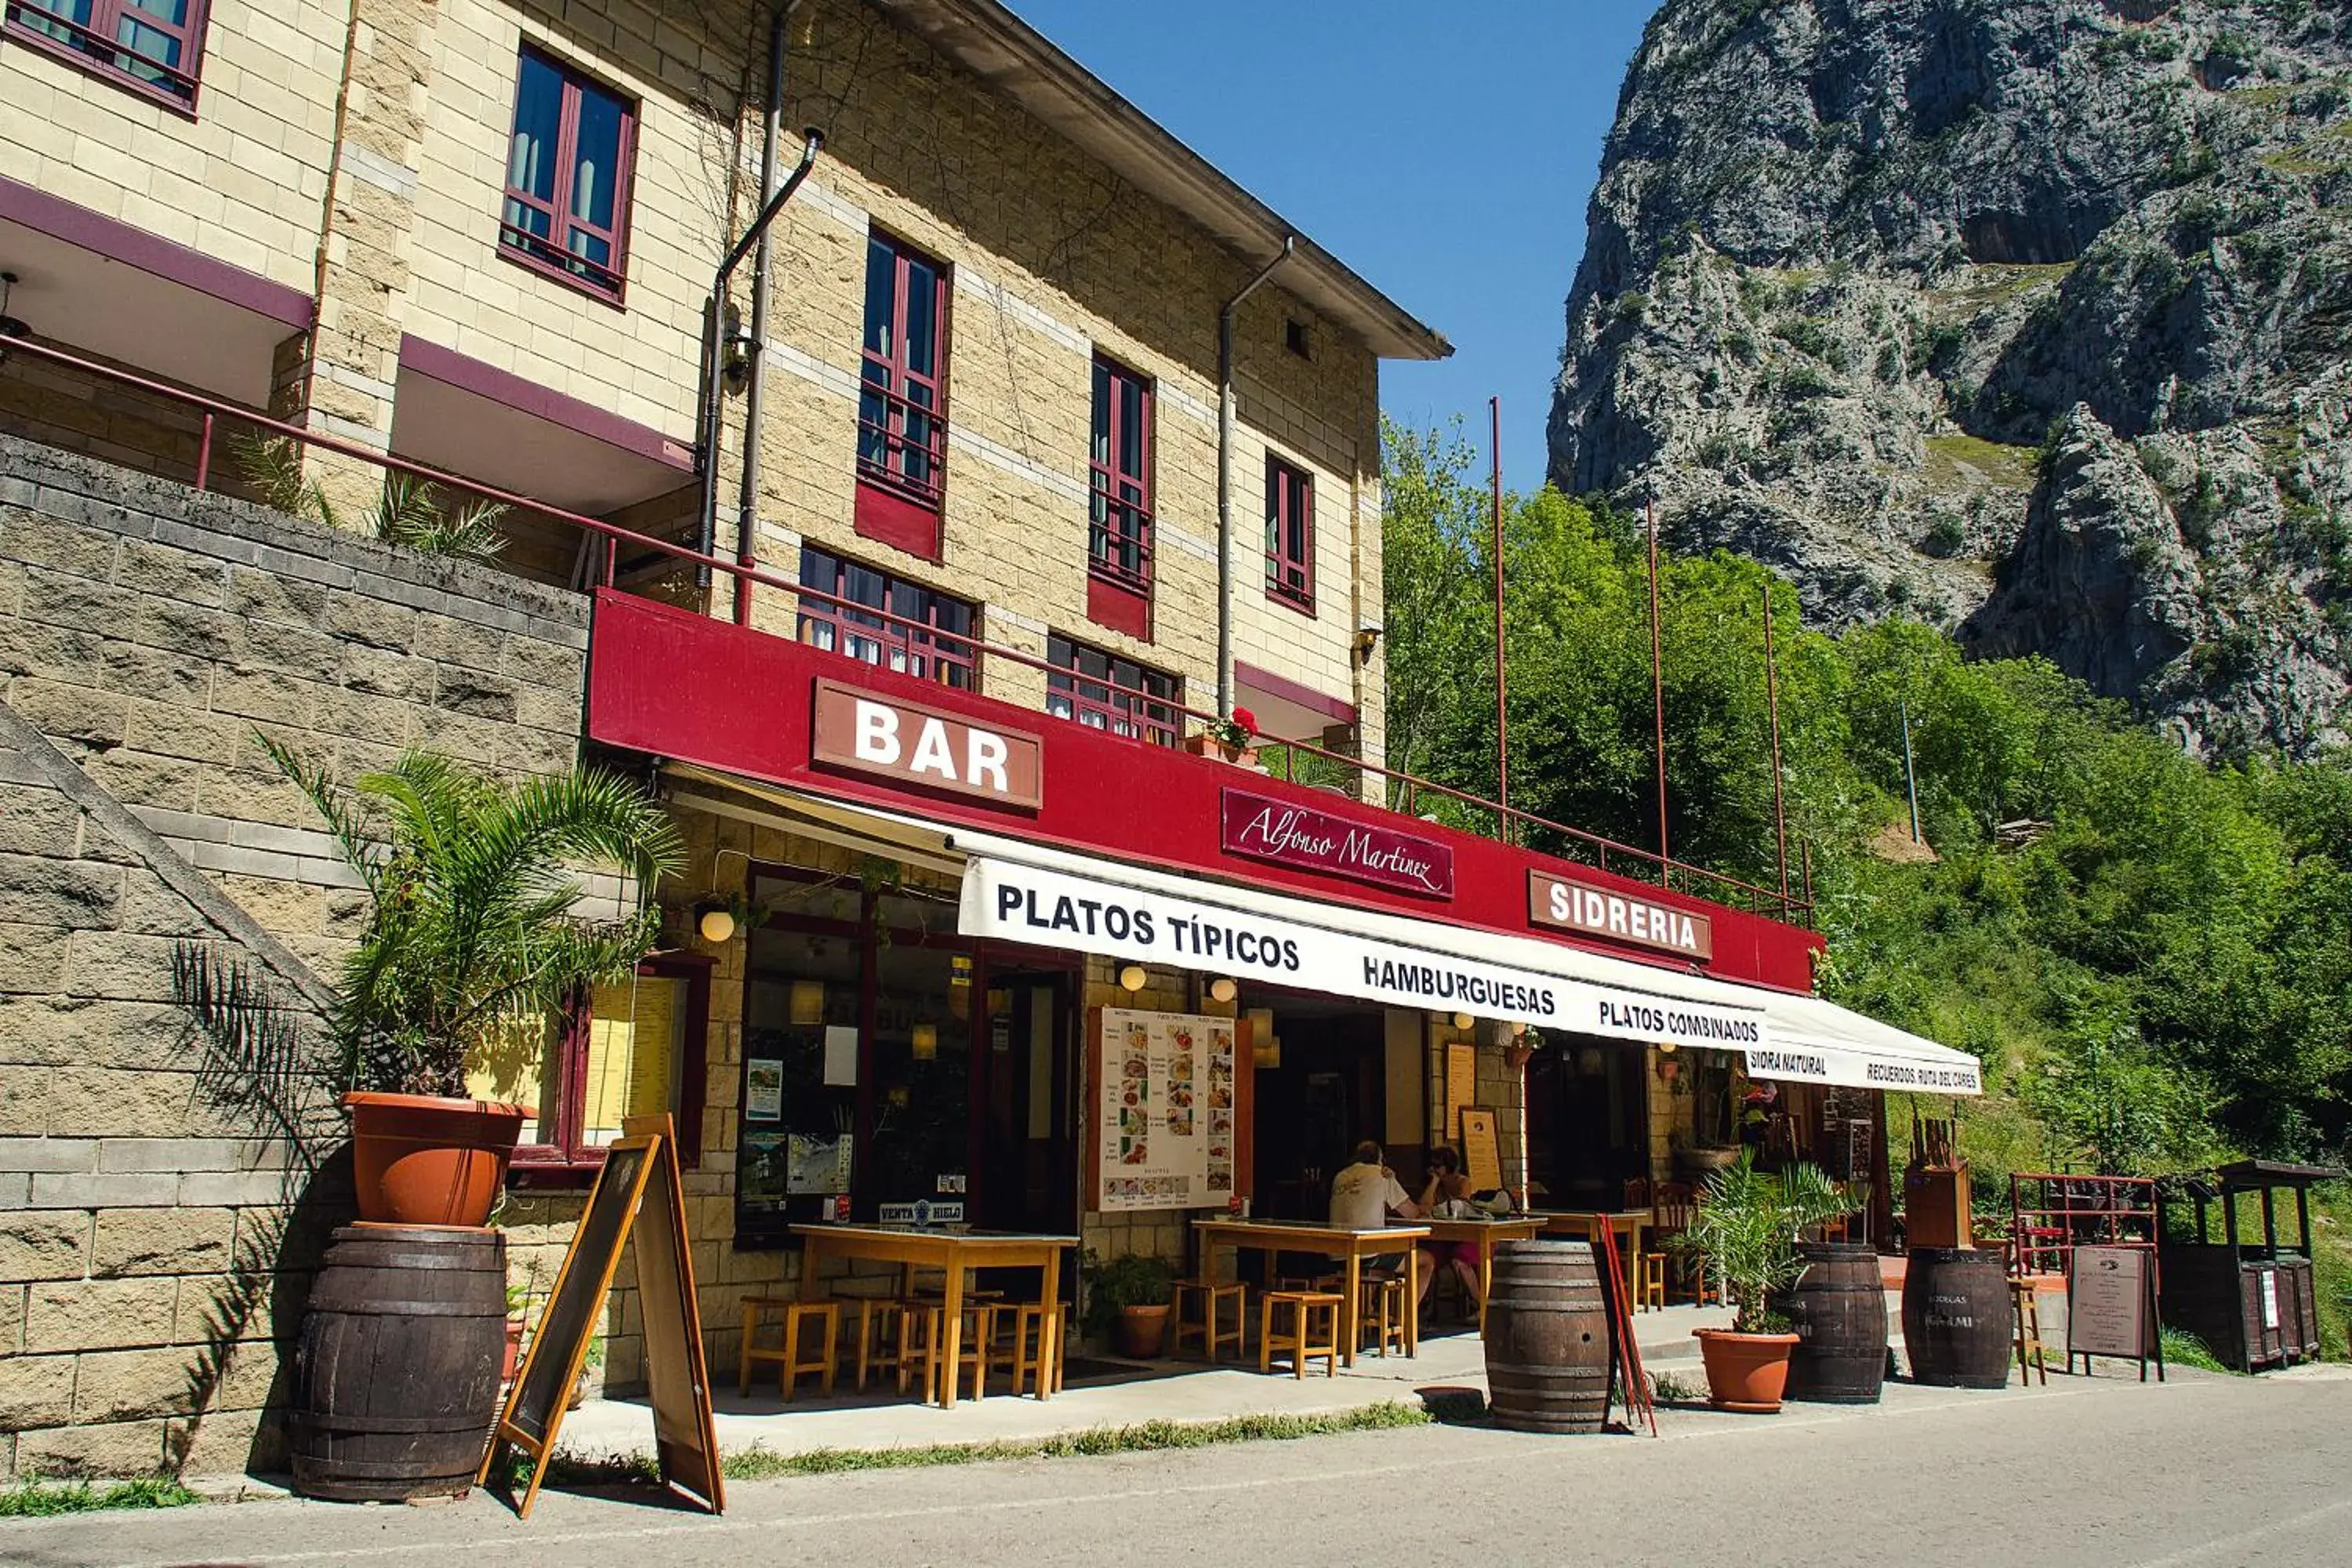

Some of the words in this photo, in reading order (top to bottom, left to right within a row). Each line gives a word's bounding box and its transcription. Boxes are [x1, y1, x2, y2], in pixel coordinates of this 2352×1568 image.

[855, 699, 1008, 792] BAR
[1240, 806, 1336, 855] Alfonso
[1339, 829, 1443, 891] Martinez
[997, 884, 1156, 945] PLATOS
[1167, 913, 1300, 971] TÍPICOS
[1550, 882, 1697, 949] SIDRERIA
[1363, 956, 1555, 1015] HAMBURGUESAS
[1599, 1001, 1664, 1032] PLATOS
[1668, 1012, 1759, 1042] COMBINADOS
[1751, 1051, 1781, 1071] SIDRA
[1782, 1053, 1827, 1076] NATURAL
[1918, 1069, 1937, 1086] RUTA
[1939, 1071, 1951, 1087] DEL
[882, 1207, 914, 1219] VENTA
[933, 1207, 960, 1218] HIELO
